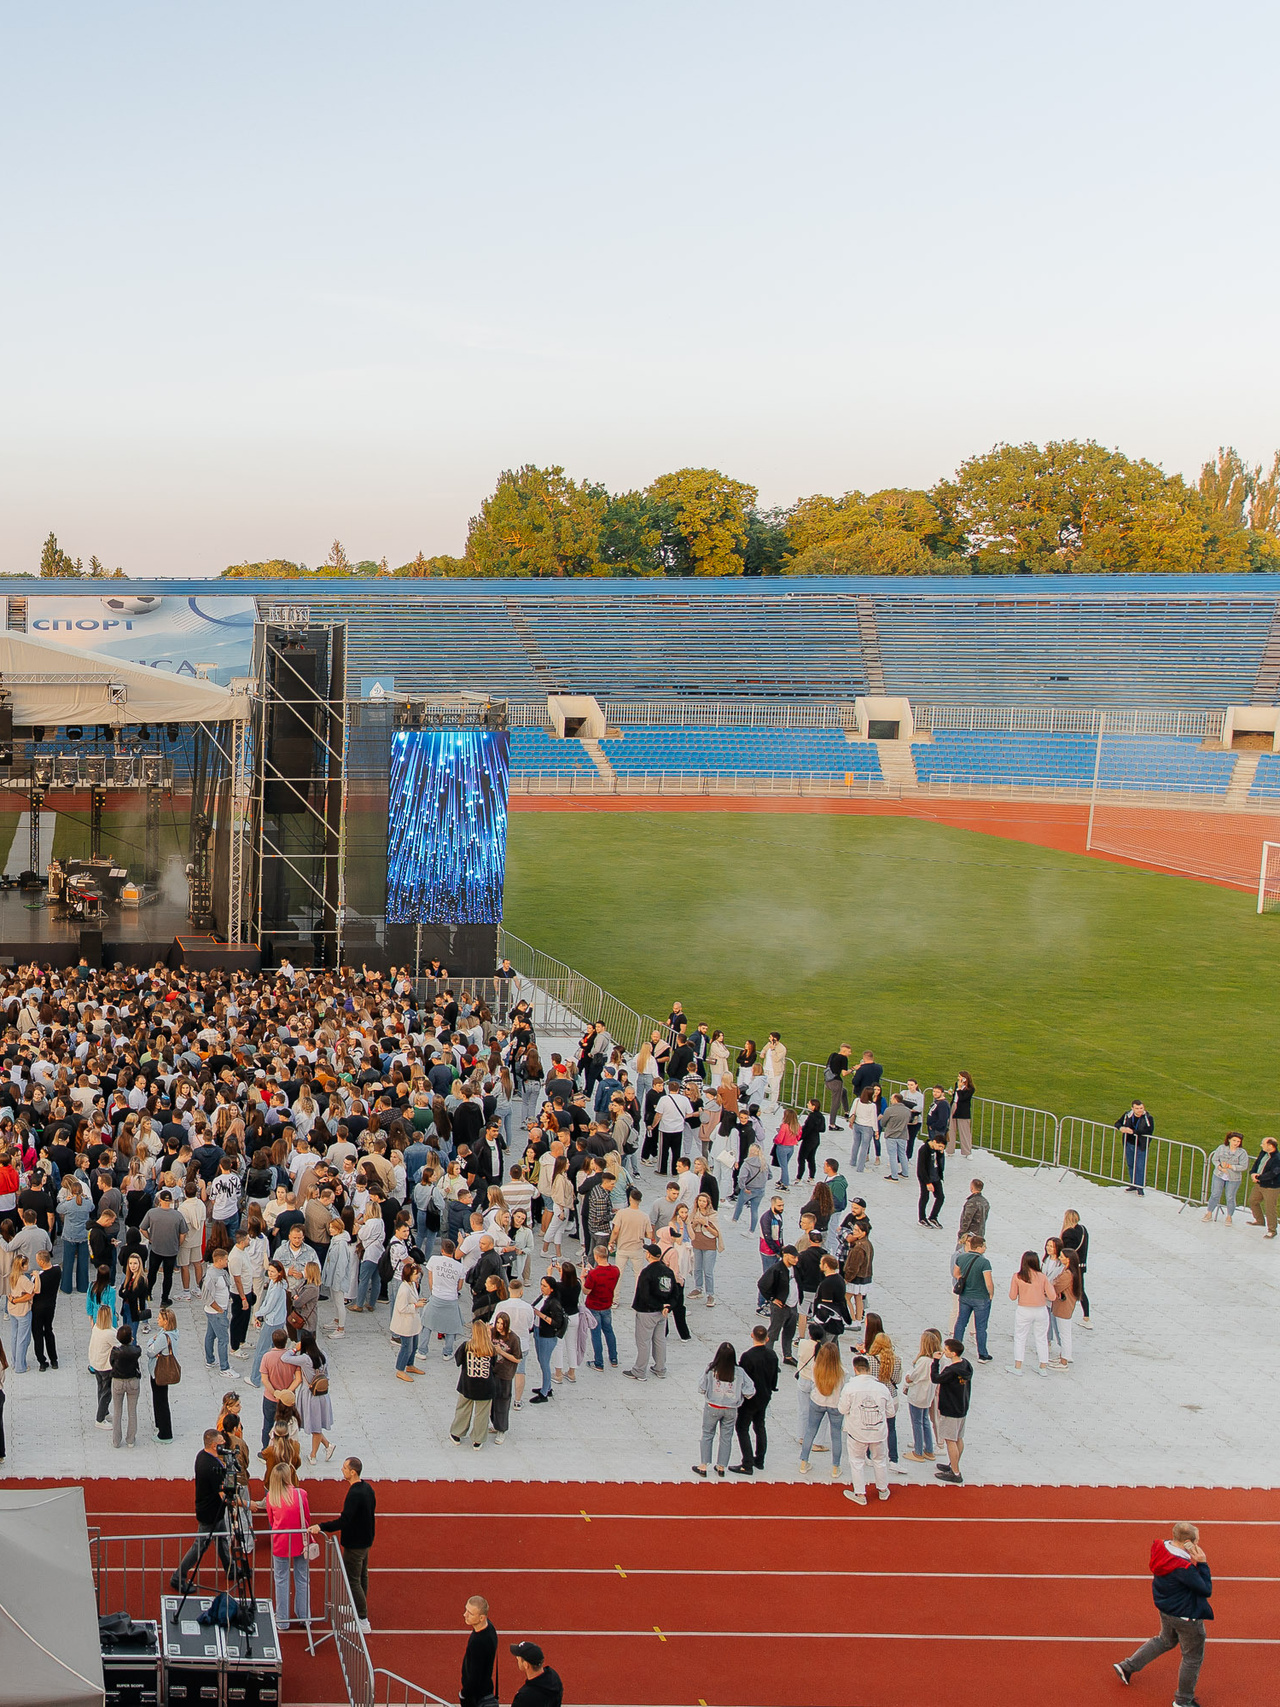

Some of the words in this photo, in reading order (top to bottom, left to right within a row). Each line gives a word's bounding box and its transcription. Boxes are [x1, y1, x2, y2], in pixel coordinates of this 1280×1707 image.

[32, 619, 136, 631] СПОРТ
[467, 1360, 490, 1370] INS
[467, 1368, 490, 1378] INS
